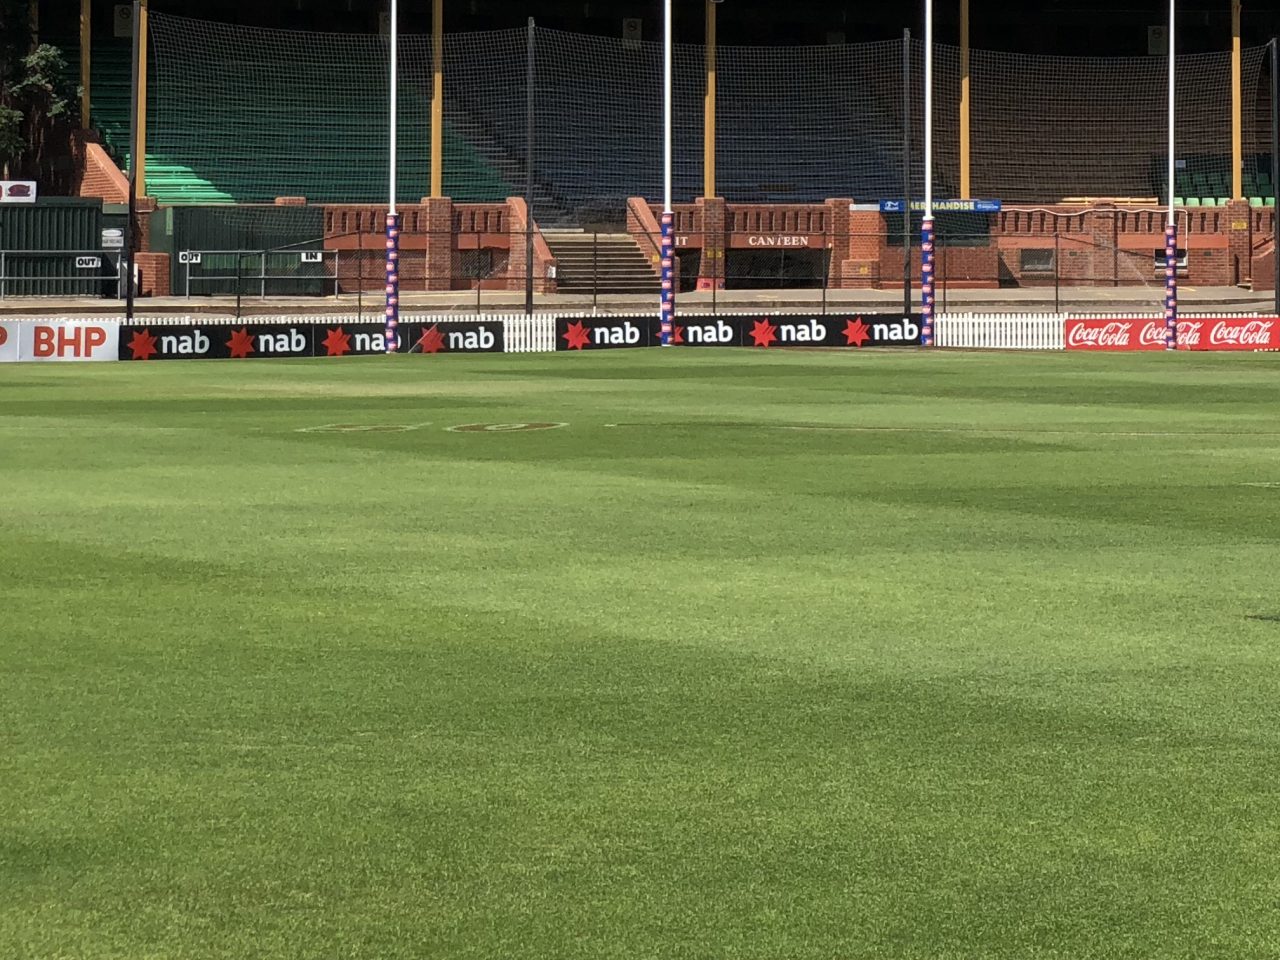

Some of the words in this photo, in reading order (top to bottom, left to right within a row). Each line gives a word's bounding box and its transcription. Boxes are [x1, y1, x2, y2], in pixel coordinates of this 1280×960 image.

[911, 201, 975, 211] ERHANDISE
[749, 236, 809, 246] CANTEEN
[77, 258, 96, 266] OUT
[180, 253, 200, 261] OUT
[305, 252, 318, 260] IN
[33, 325, 107, 357] BHP
[259, 328, 306, 352] nab
[449, 326, 494, 349] nab
[594, 321, 640, 345] nab
[687, 320, 733, 343] nab
[780, 319, 826, 342] nab
[873, 318, 919, 341] nab
[162, 330, 210, 354] nab
[355, 332, 401, 351] na
